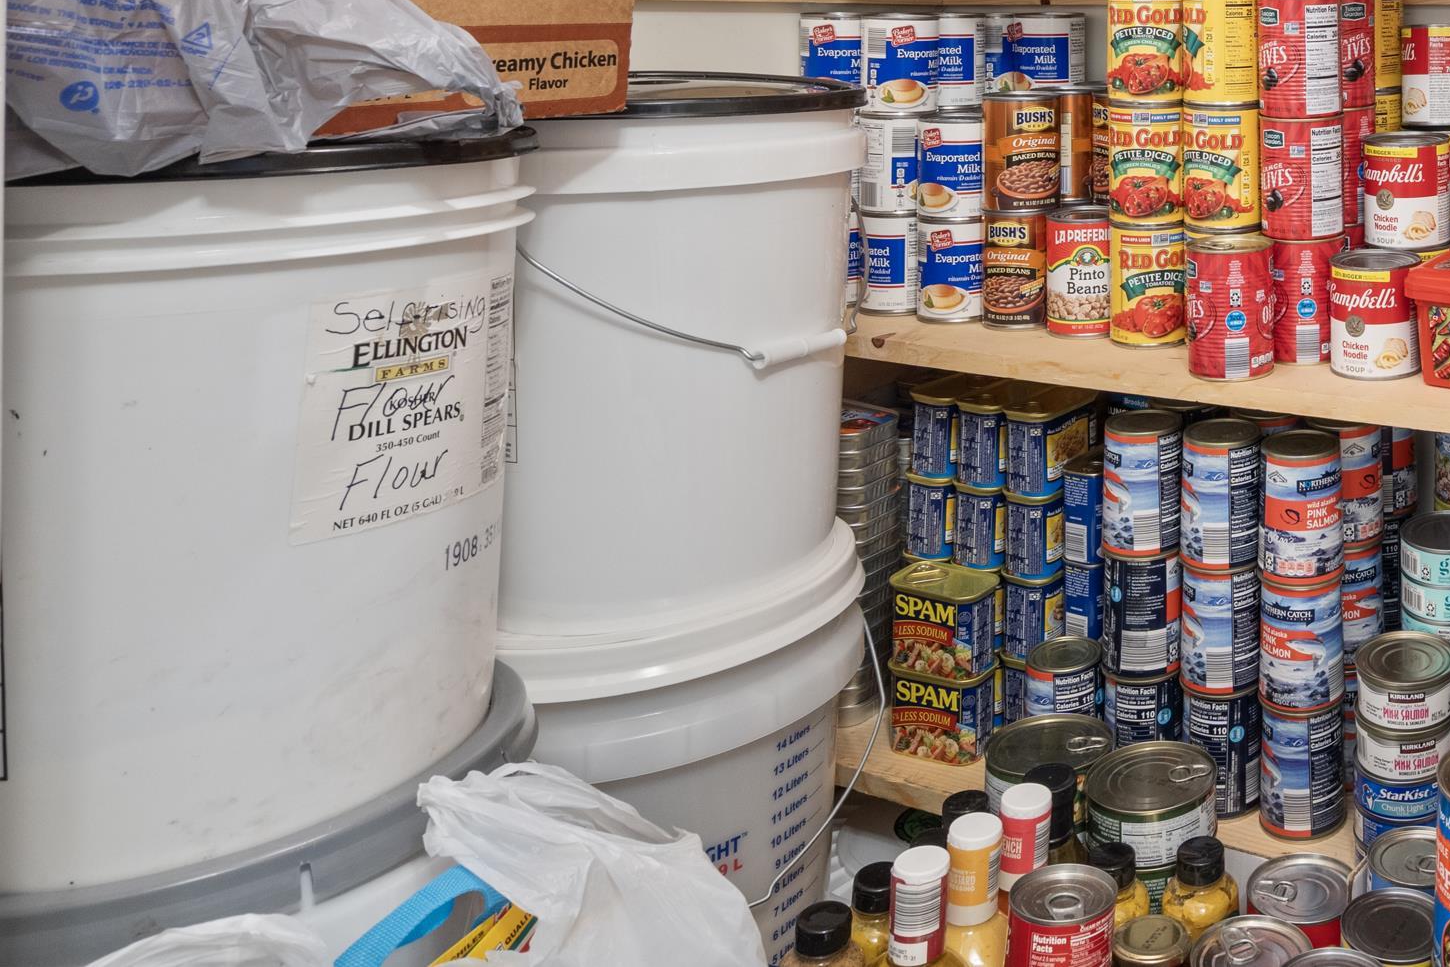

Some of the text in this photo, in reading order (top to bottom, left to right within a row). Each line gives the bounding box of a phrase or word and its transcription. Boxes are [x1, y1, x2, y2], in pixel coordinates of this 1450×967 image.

[1115, 27, 1174, 41] PETITE DICED
[492, 50, 617, 76] reamy Chicken
[1034, 54, 1057, 64] Milk
[528, 76, 569, 92] Flavor
[1016, 110, 1053, 126] BUSH'S
[1012, 136, 1055, 149] Original
[926, 151, 980, 164] Evaporated
[1012, 151, 1056, 161] BAKED BEANS
[957, 163, 980, 173] Milk
[1373, 214, 1398, 224] Chicken
[989, 225, 1026, 240] BUSH'S
[1374, 222, 1398, 232] Noodle
[987, 250, 1030, 262] Original
[1118, 249, 1152, 270] RED
[1069, 267, 1105, 281] Pinto
[1129, 274, 1159, 287] PETITE
[1066, 281, 1108, 295] Beans
[351, 325, 468, 369] ELLINGTON
[1342, 340, 1369, 351] Chicken
[1343, 349, 1368, 360] Noodle
[381, 358, 448, 380] FARMS
[389, 392, 436, 411] KOSHER
[348, 401, 461, 442] DILL SPEARS
[375, 430, 441, 453] 350-450 Count
[339, 449, 448, 511] Flour
[1306, 513, 1339, 529] SALMON
[1307, 508, 1328, 519] PINK
[895, 592, 956, 627] SPAM
[899, 626, 948, 642] LESS SODIUM
[1262, 644, 1291, 659] SALMON
[896, 679, 959, 712] SPAM
[1389, 693, 1425, 701] KIRKLAND
[900, 713, 951, 728] LESS SODIUM
[776, 724, 811, 752] 14 Liters
[1402, 740, 1435, 751] KIRKLAND
[772, 771, 809, 801] 12 Liters
[1379, 788, 1429, 801] StarKist
